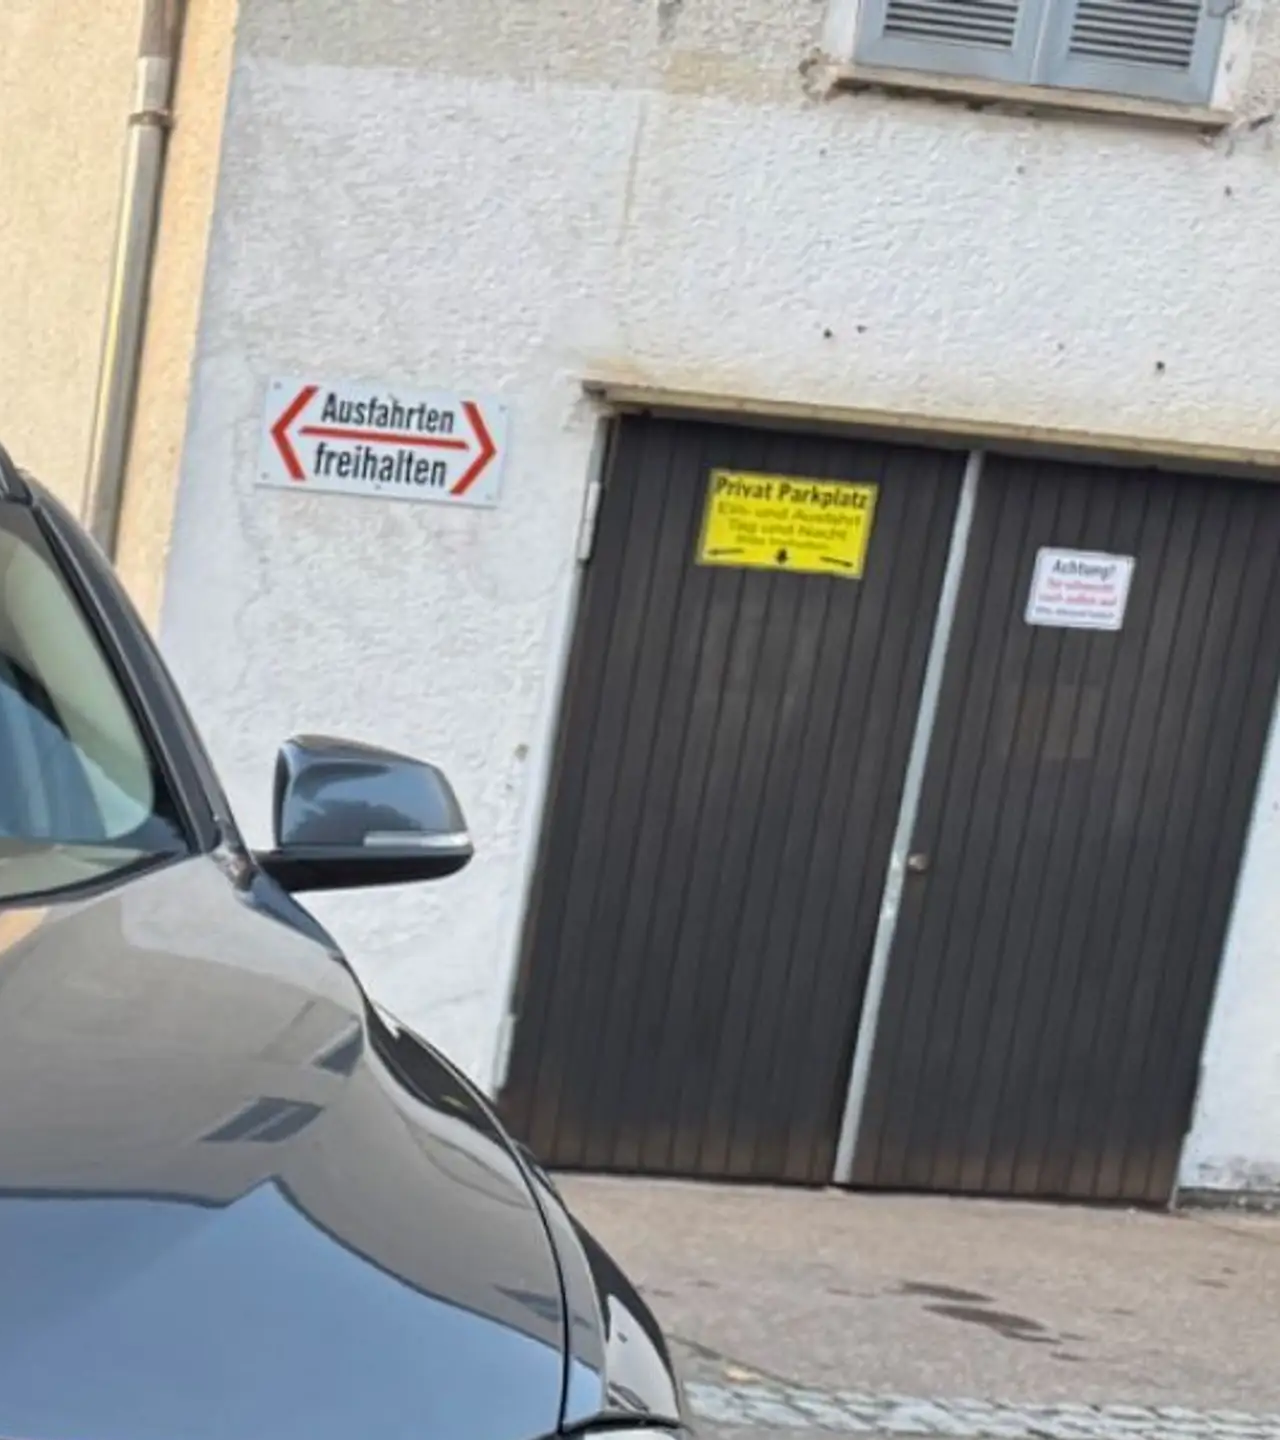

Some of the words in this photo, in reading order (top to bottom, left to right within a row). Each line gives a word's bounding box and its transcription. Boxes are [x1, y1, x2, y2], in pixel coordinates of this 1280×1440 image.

[321, 392, 454, 434] Ausfahrten
[314, 441, 448, 487] freihalten
[716, 475, 772, 502] Privat
[778, 482, 868, 509] Parkplatz
